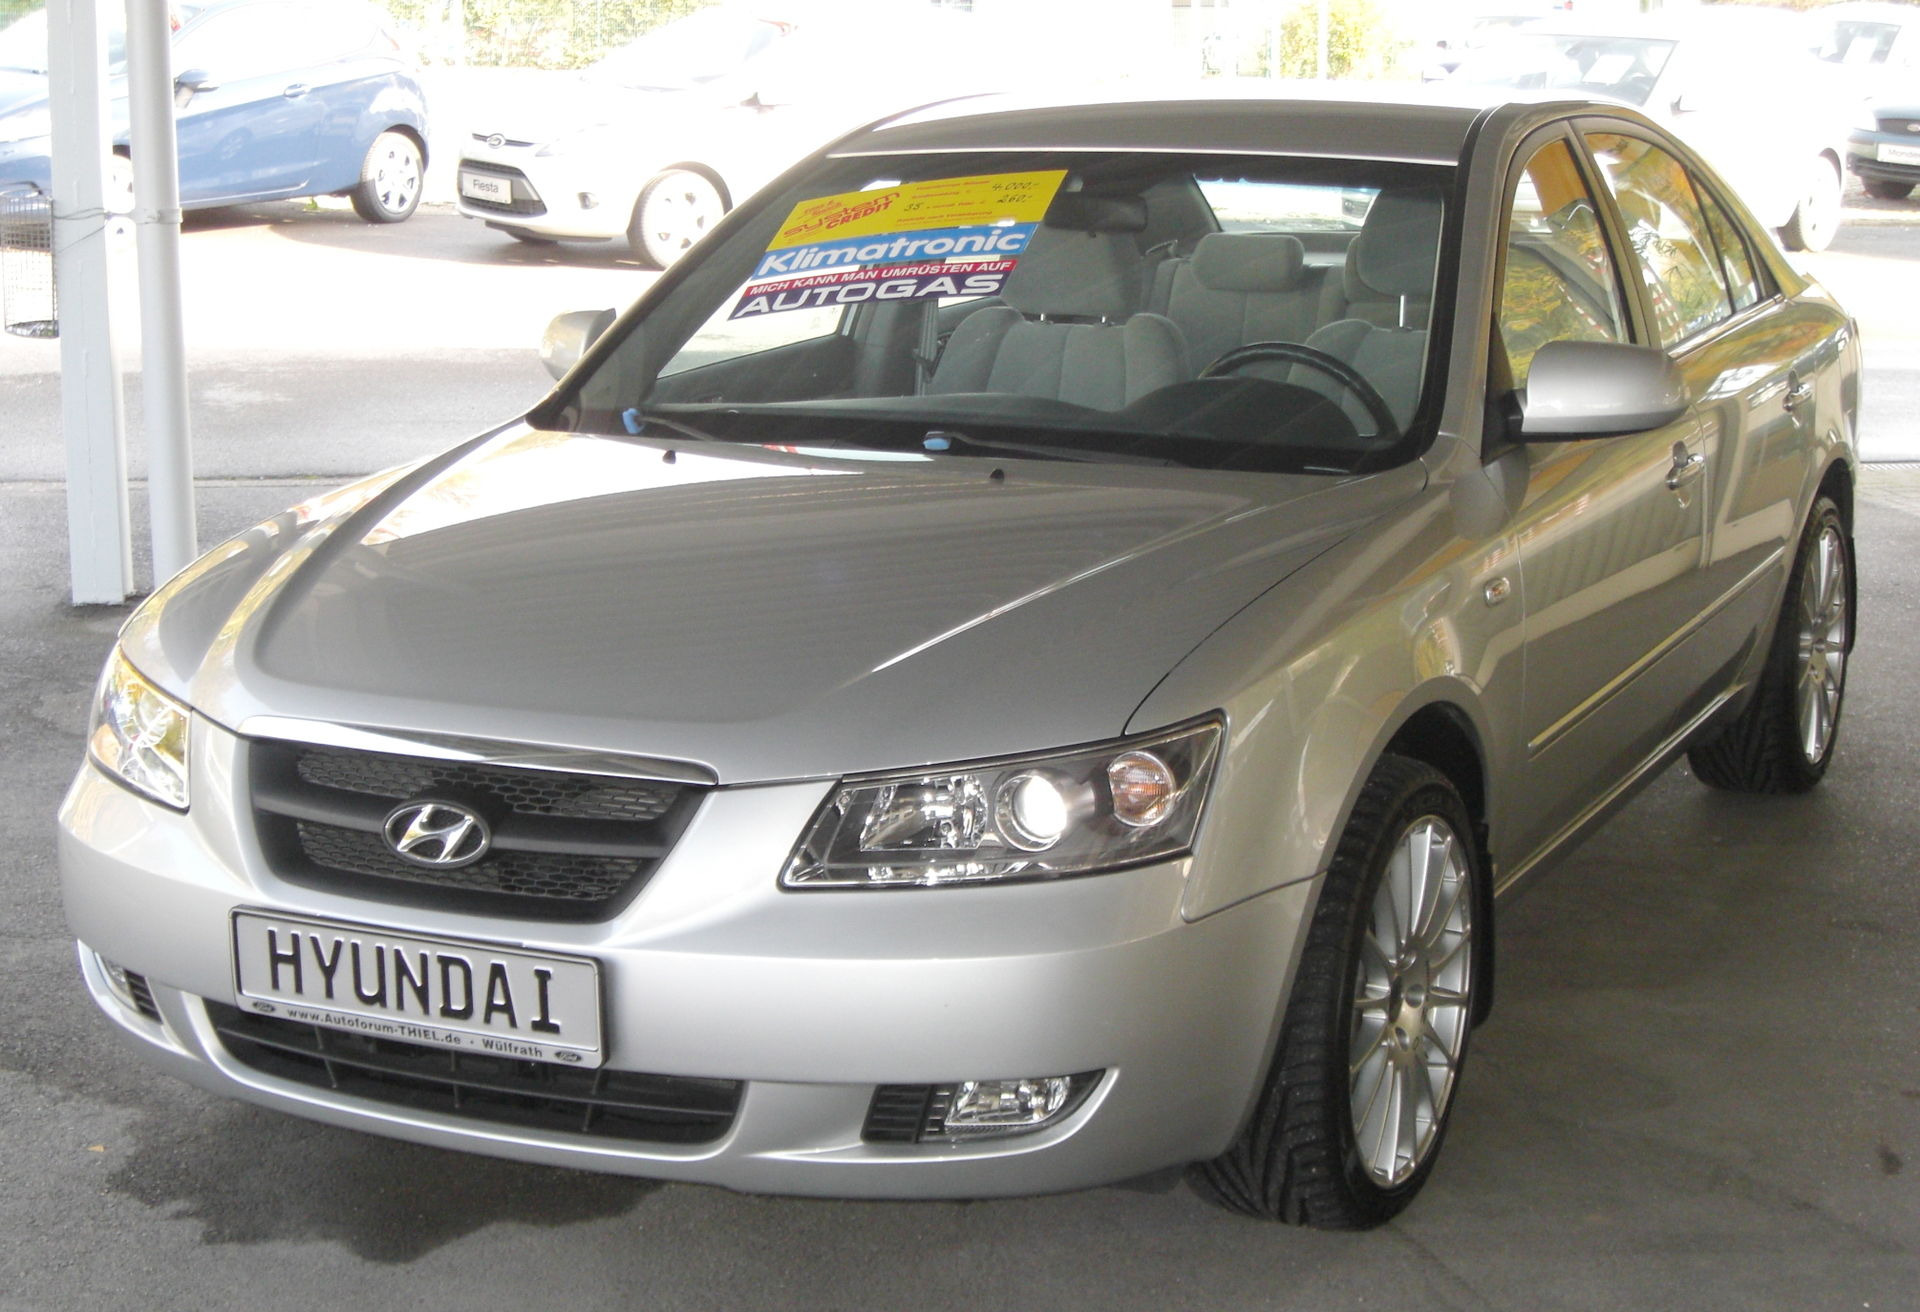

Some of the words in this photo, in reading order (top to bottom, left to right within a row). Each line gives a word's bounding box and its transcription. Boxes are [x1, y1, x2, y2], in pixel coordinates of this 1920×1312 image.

[473, 179, 499, 193] Fiesta
[825, 200, 893, 229] CREDIT
[757, 229, 1026, 276] Klimatronic
[734, 274, 1004, 317] AUTOGAS
[750, 282, 788, 295] MICH
[792, 274, 839, 289] KANN
[841, 270, 881, 282] MAN
[882, 263, 973, 279] UMRÜSTEN
[976, 261, 1012, 272] AUF
[267, 927, 561, 1034] HYUNDAI
[287, 1008, 461, 1045] www.Autoforum-THIEL.de
[482, 1038, 543, 1058] Wülfrath
